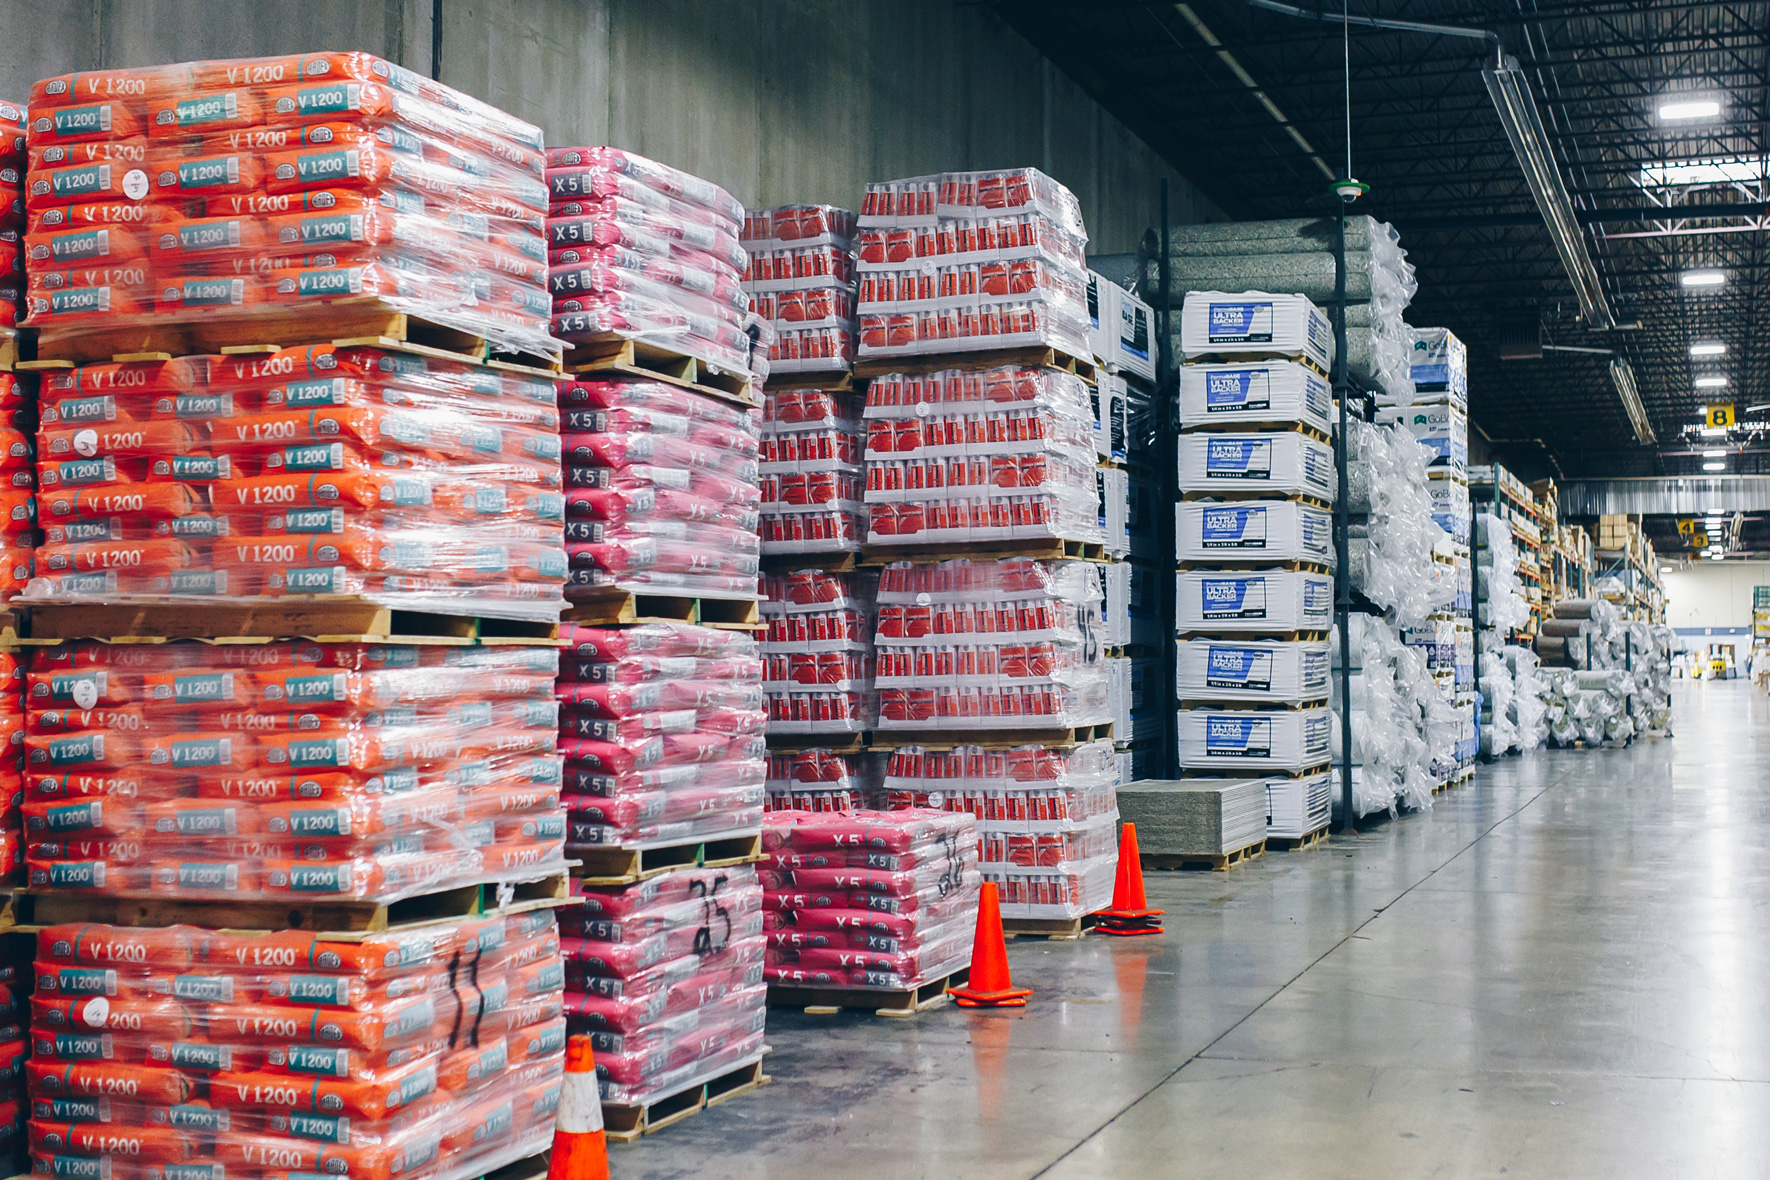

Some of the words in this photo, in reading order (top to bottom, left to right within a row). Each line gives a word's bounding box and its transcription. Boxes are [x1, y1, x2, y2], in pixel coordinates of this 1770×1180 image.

[225, 68, 237, 84] V
[244, 65, 284, 84] 1200
[89, 78, 100, 94] V
[106, 78, 145, 94] 1200
[298, 96, 306, 108] V
[311, 92, 342, 106] 1200
[55, 115, 63, 128] V
[67, 113, 95, 127] 1200
[227, 133, 240, 148] V
[246, 132, 286, 148] 1200
[86, 144, 98, 160] V
[104, 144, 144, 161] 1200
[179, 168, 188, 182] V
[192, 166, 222, 180] 1200
[298, 162, 306, 175] V
[312, 158, 342, 173] 1200
[53, 178, 61, 190] V
[66, 173, 94, 188] 1200
[555, 178, 565, 192] X
[569, 178, 578, 191] 5
[232, 197, 242, 213] V
[248, 196, 288, 212] 1200
[84, 206, 96, 221] V
[102, 206, 142, 221] 1200
[556, 228, 565, 241] X
[569, 225, 578, 239] 5
[554, 277, 564, 290] X
[568, 274, 577, 288] 5
[52, 297, 60, 309] V
[64, 294, 92, 308] 1200
[562, 319, 571, 332] X
[576, 317, 585, 329] 5
[236, 365, 243, 378] V
[252, 356, 293, 377] 1200
[286, 388, 294, 400] V
[298, 386, 328, 400] 1200
[60, 406, 68, 418] V
[72, 403, 102, 417] 1200
[1712, 410, 1727, 425] 8
[570, 413, 579, 426] X
[583, 414, 592, 427] 5
[237, 426, 247, 441] V
[253, 420, 295, 440] 1200
[103, 432, 142, 449] 1200
[285, 452, 293, 464] V
[296, 450, 326, 464] 1200
[60, 468, 67, 480] V
[71, 461, 101, 478] 1200
[237, 488, 248, 504] V
[254, 485, 294, 503] 1200
[88, 497, 98, 512] V
[104, 494, 142, 511] 1200
[286, 514, 294, 526] V
[298, 512, 330, 526] 1200
[567, 523, 576, 536] X
[581, 524, 589, 537] 5
[1682, 523, 1690, 533] 4
[237, 546, 248, 562] V
[254, 545, 294, 562] 1200
[286, 574, 294, 586] V
[298, 573, 328, 586] 1200
[1212, 661, 1243, 669] BACKER
[1213, 655, 1243, 664] ULTRA
[175, 682, 184, 696] V
[187, 681, 220, 696] 1200
[81, 711, 92, 726] V
[98, 712, 138, 730] 1200
[580, 721, 589, 734] X
[594, 723, 602, 735] 5
[172, 748, 180, 761] V
[184, 746, 215, 760] 1200
[289, 748, 297, 761] V
[302, 746, 332, 760] 1200
[222, 780, 231, 794] V
[237, 781, 276, 796] 1200
[579, 776, 587, 788] X
[593, 778, 601, 790] 5
[291, 818, 298, 830] V
[303, 816, 335, 830] 1200
[576, 826, 585, 839] X
[590, 828, 598, 840] 5
[776, 855, 785, 868] X
[792, 854, 800, 867] 5
[868, 854, 877, 866] X
[879, 856, 887, 867] 5
[50, 865, 57, 882] V
[61, 868, 88, 882] 1200
[290, 873, 298, 885] V
[303, 872, 333, 885] 1200
[778, 895, 789, 908] X
[794, 895, 804, 908] 5
[869, 895, 878, 907] X
[879, 898, 887, 910] 5
[868, 936, 877, 947] X
[879, 939, 887, 949] 5
[236, 948, 246, 964] V
[254, 948, 295, 965] 1200
[60, 976, 67, 988] V
[72, 977, 101, 989] 1200
[586, 976, 595, 989] X
[600, 980, 608, 992] 5
[290, 983, 298, 996] V
[301, 984, 331, 998] 1200
[56, 1040, 64, 1052] V
[68, 1040, 96, 1053] 1200
[80, 1077, 91, 1093] V
[96, 1077, 136, 1094] 1200
[237, 1085, 248, 1102] V
[254, 1086, 296, 1104] 1200
[54, 1104, 60, 1116] V
[65, 1104, 94, 1116] 1200
[291, 1119, 299, 1131] V
[301, 1119, 331, 1135] 1200
